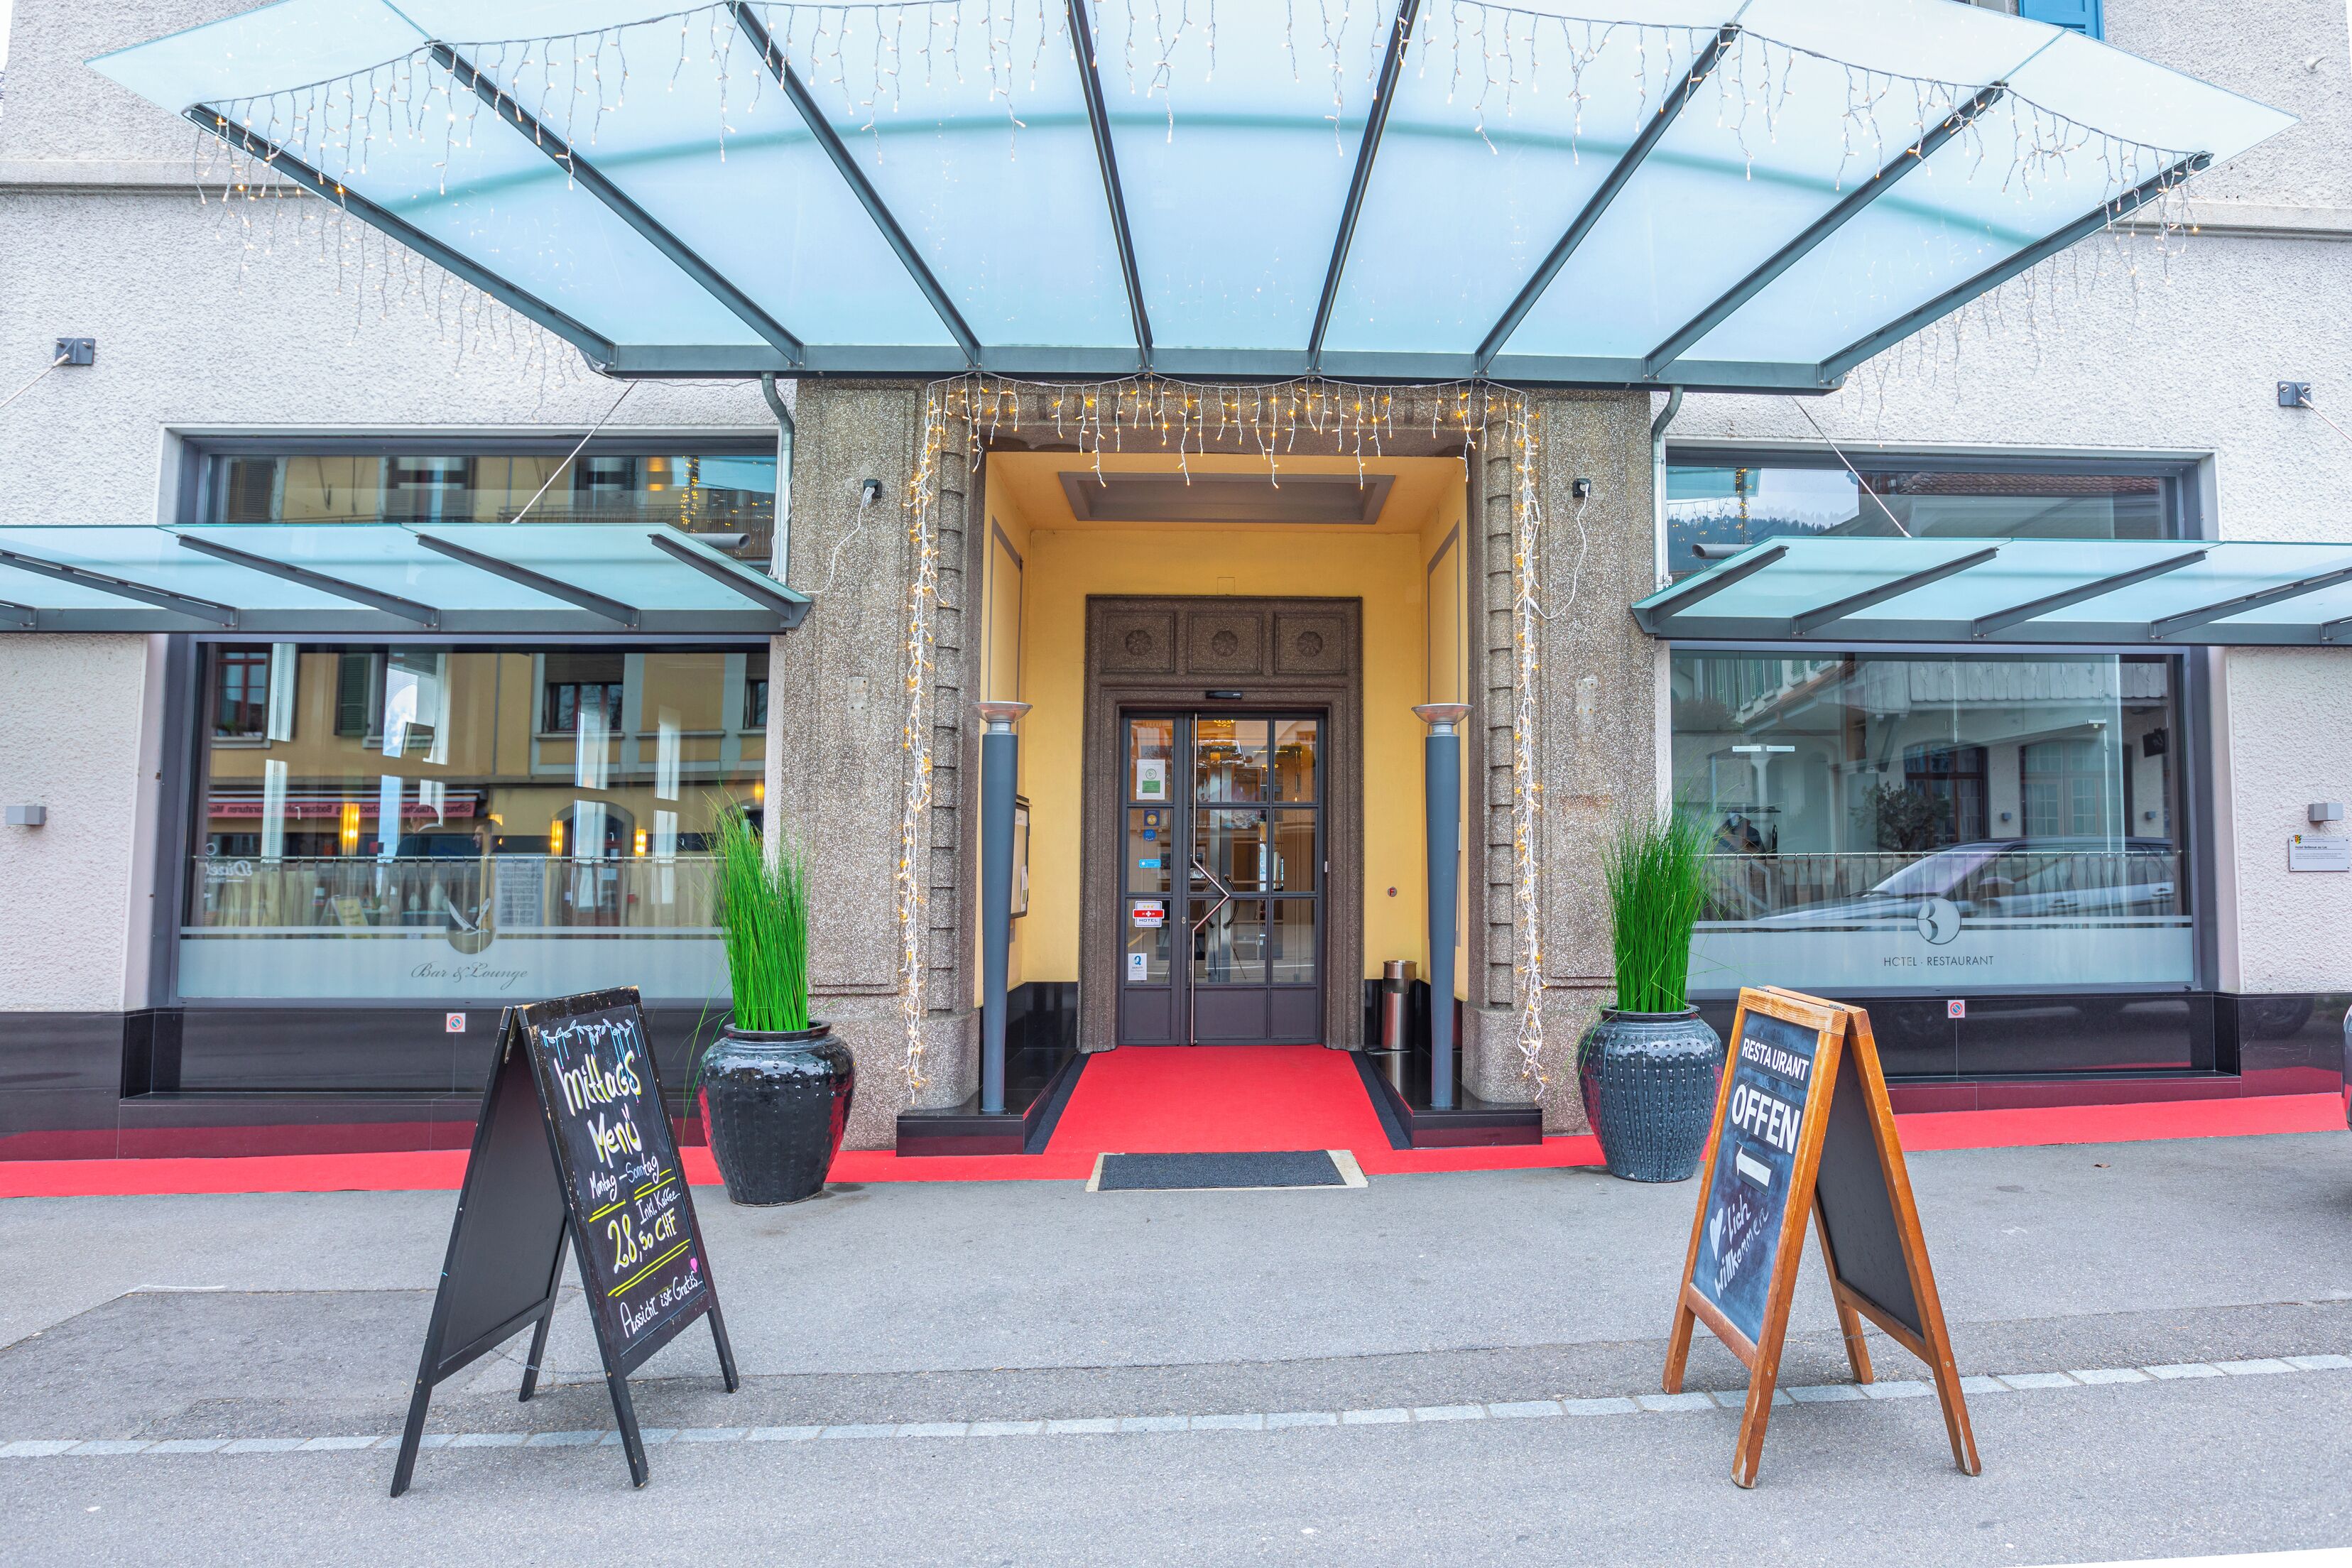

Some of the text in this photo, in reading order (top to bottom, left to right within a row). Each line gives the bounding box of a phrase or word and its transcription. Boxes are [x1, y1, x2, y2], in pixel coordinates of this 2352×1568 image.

[410, 961, 528, 991] Bar & Lounge
[1884, 955, 1994, 967] HOTEL RESTAURANT
[1741, 1038, 1809, 1082] RESTAURANT
[1731, 1084, 1800, 1155] OFFEN
[589, 1170, 618, 1202] Montag
[655, 1207, 677, 1241] CHF
[620, 1296, 659, 1339] Aussicht
[660, 1288, 674, 1307] ist
